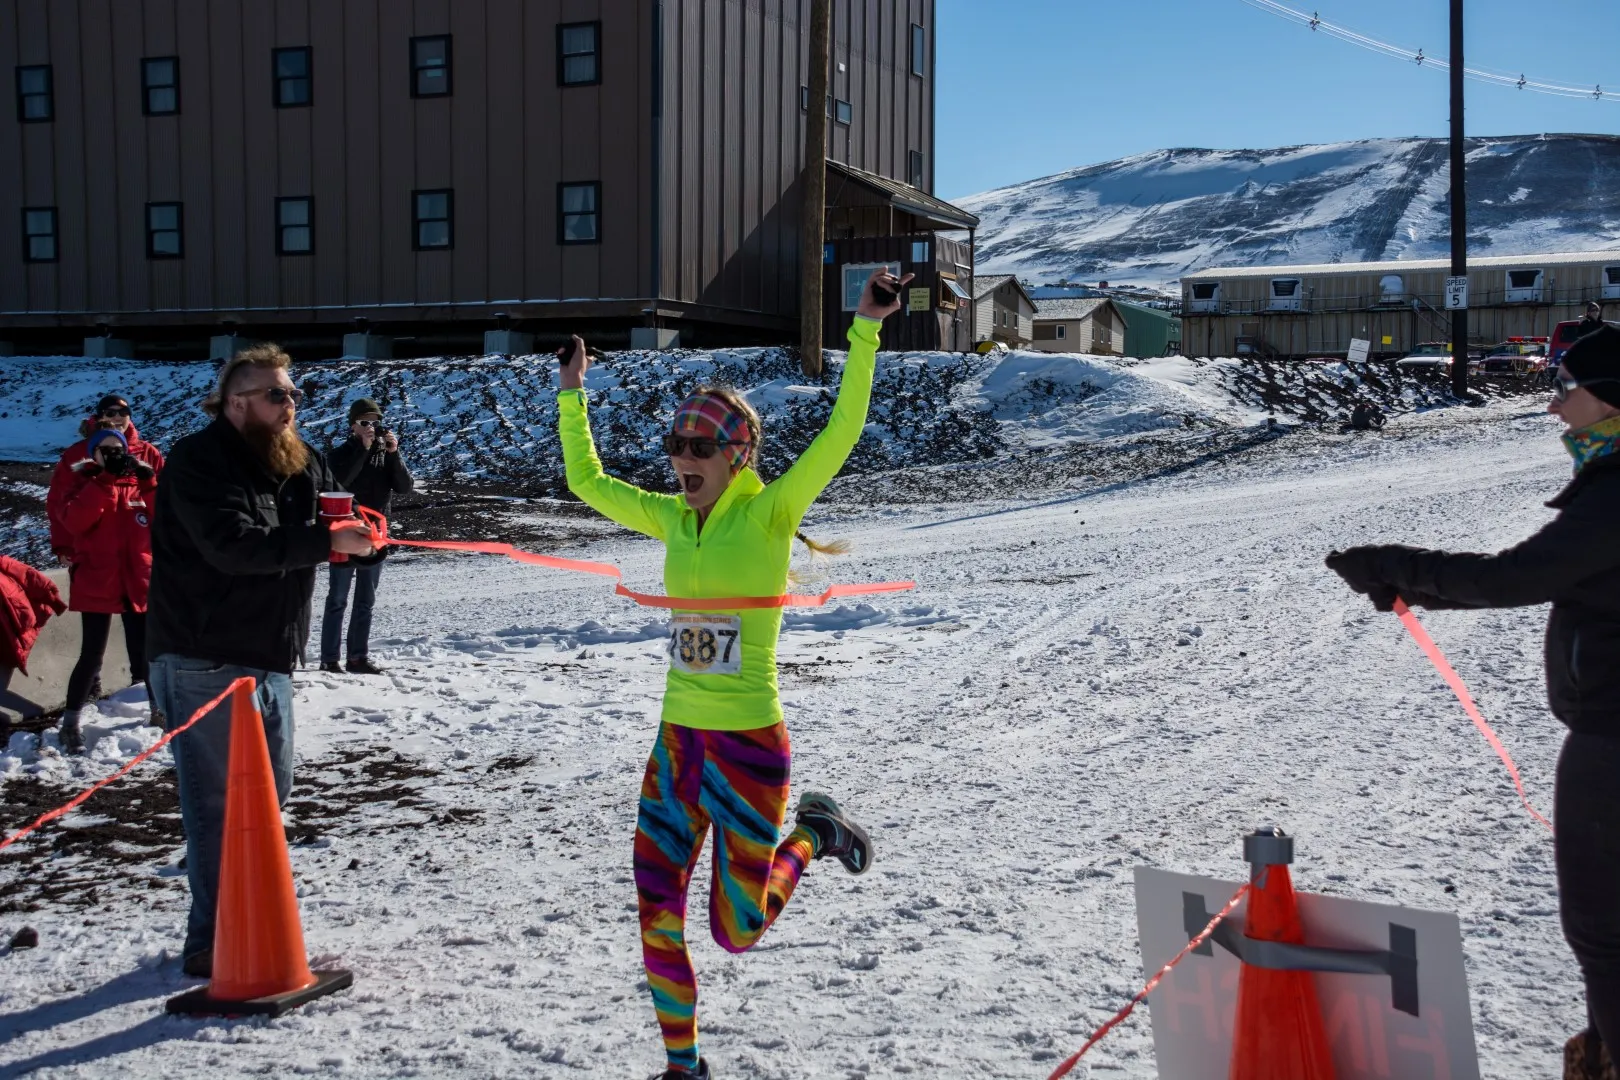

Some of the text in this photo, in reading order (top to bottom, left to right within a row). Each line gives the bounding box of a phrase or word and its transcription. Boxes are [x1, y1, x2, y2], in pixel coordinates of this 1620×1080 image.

[1446, 278, 1467, 287] SPEED
[1448, 286, 1465, 294] LIMIT
[1452, 294, 1460, 306] 5
